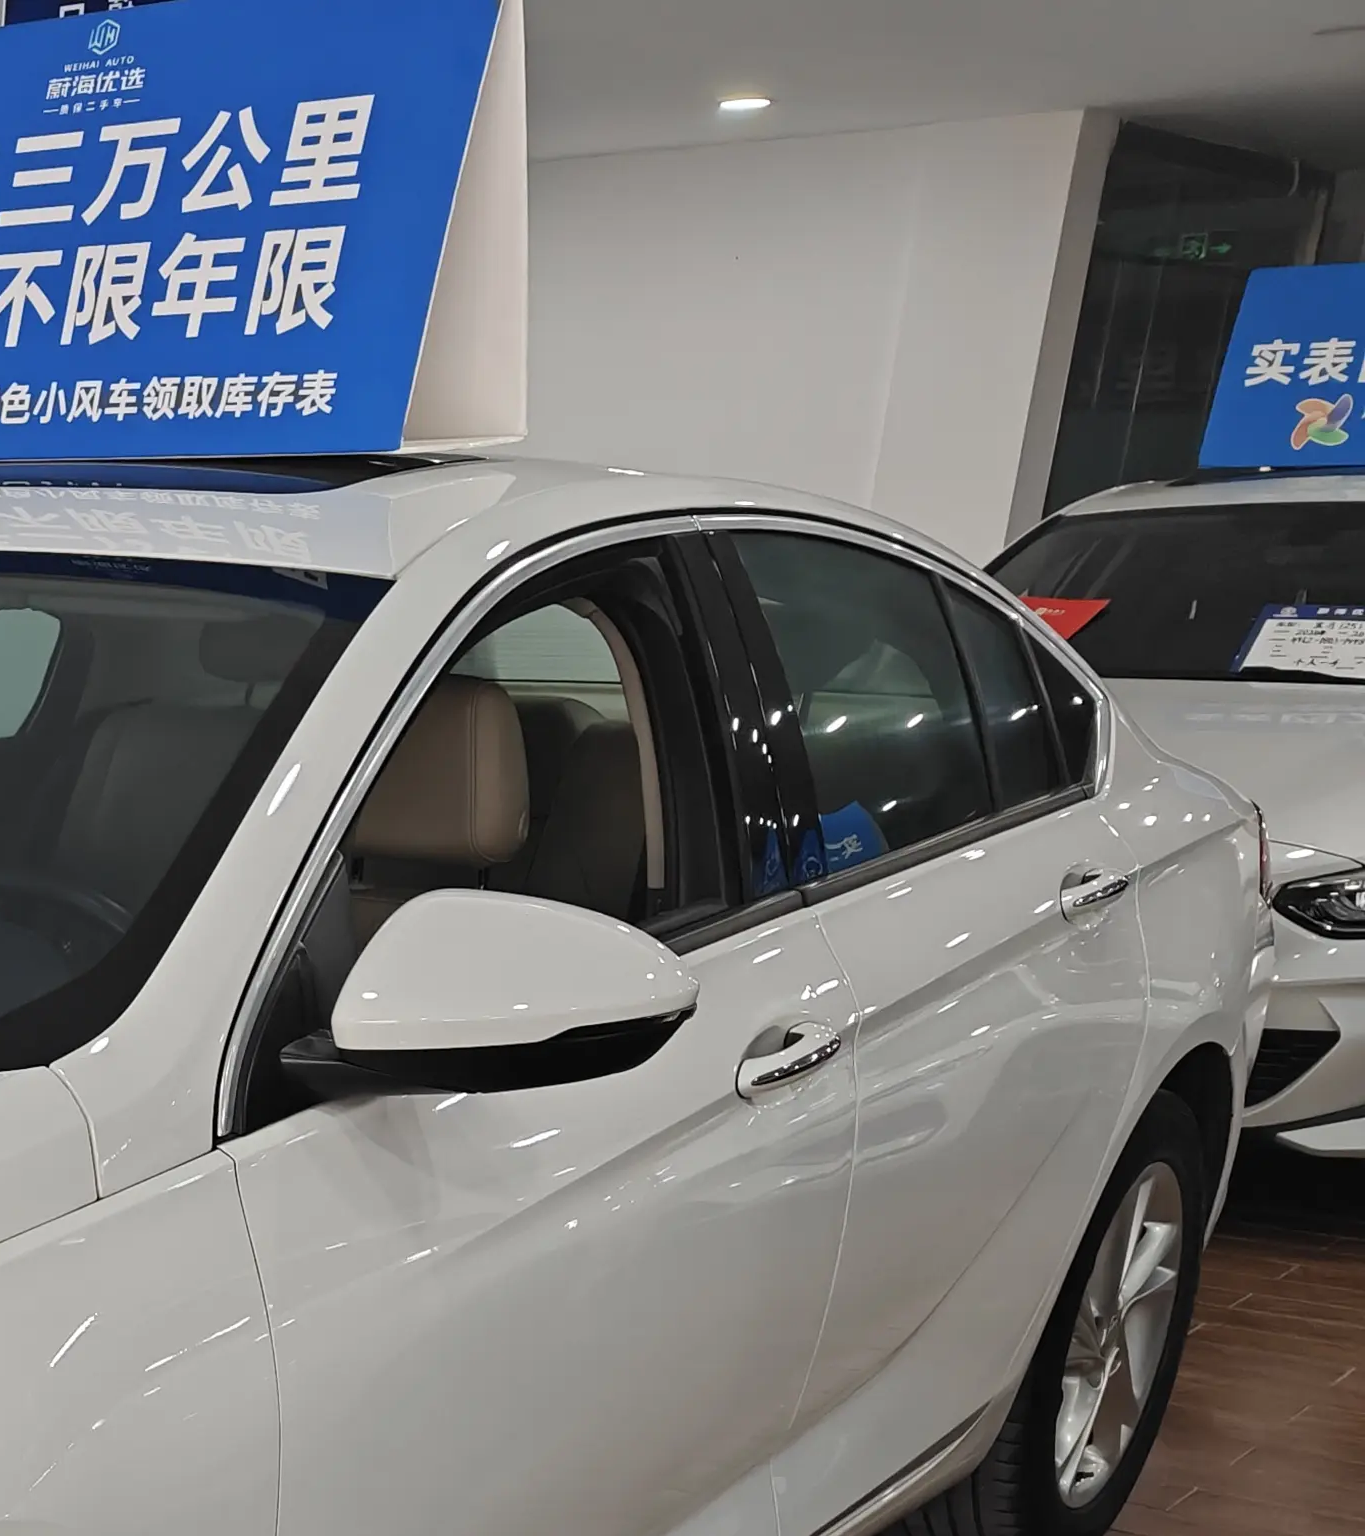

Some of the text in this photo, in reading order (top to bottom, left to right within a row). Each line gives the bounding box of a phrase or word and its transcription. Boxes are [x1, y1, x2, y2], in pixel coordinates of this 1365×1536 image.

[64, 55, 135, 73] WEIHAI AUTO
[45, 67, 146, 100] 蔚海优选
[1244, 337, 1365, 388] 实表
